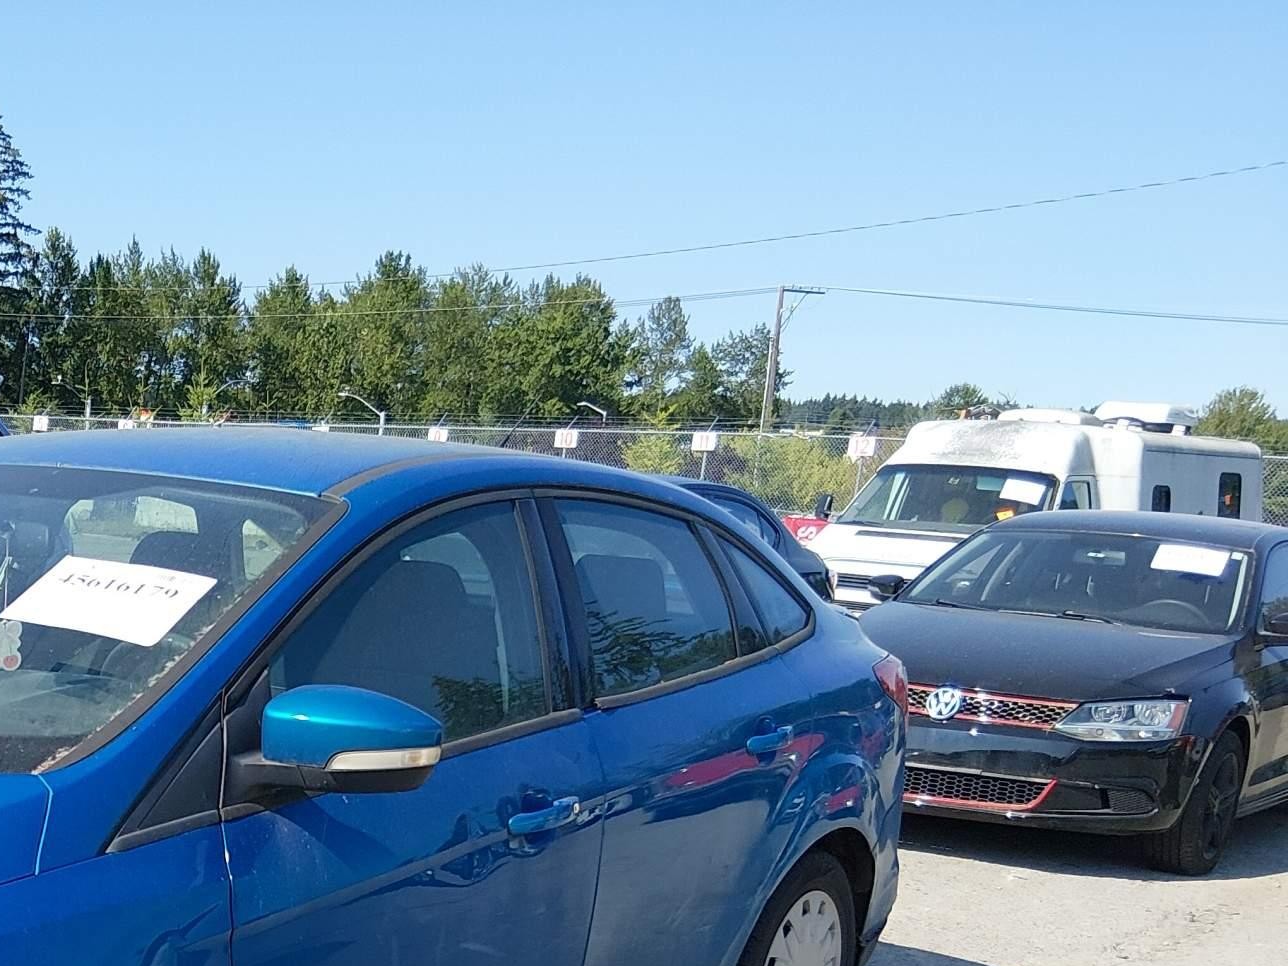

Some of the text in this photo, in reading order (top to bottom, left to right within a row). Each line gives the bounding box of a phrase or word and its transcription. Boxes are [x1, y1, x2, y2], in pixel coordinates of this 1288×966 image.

[560, 431, 573, 447] 10
[700, 434, 709, 449] 11
[855, 438, 869, 454] 12
